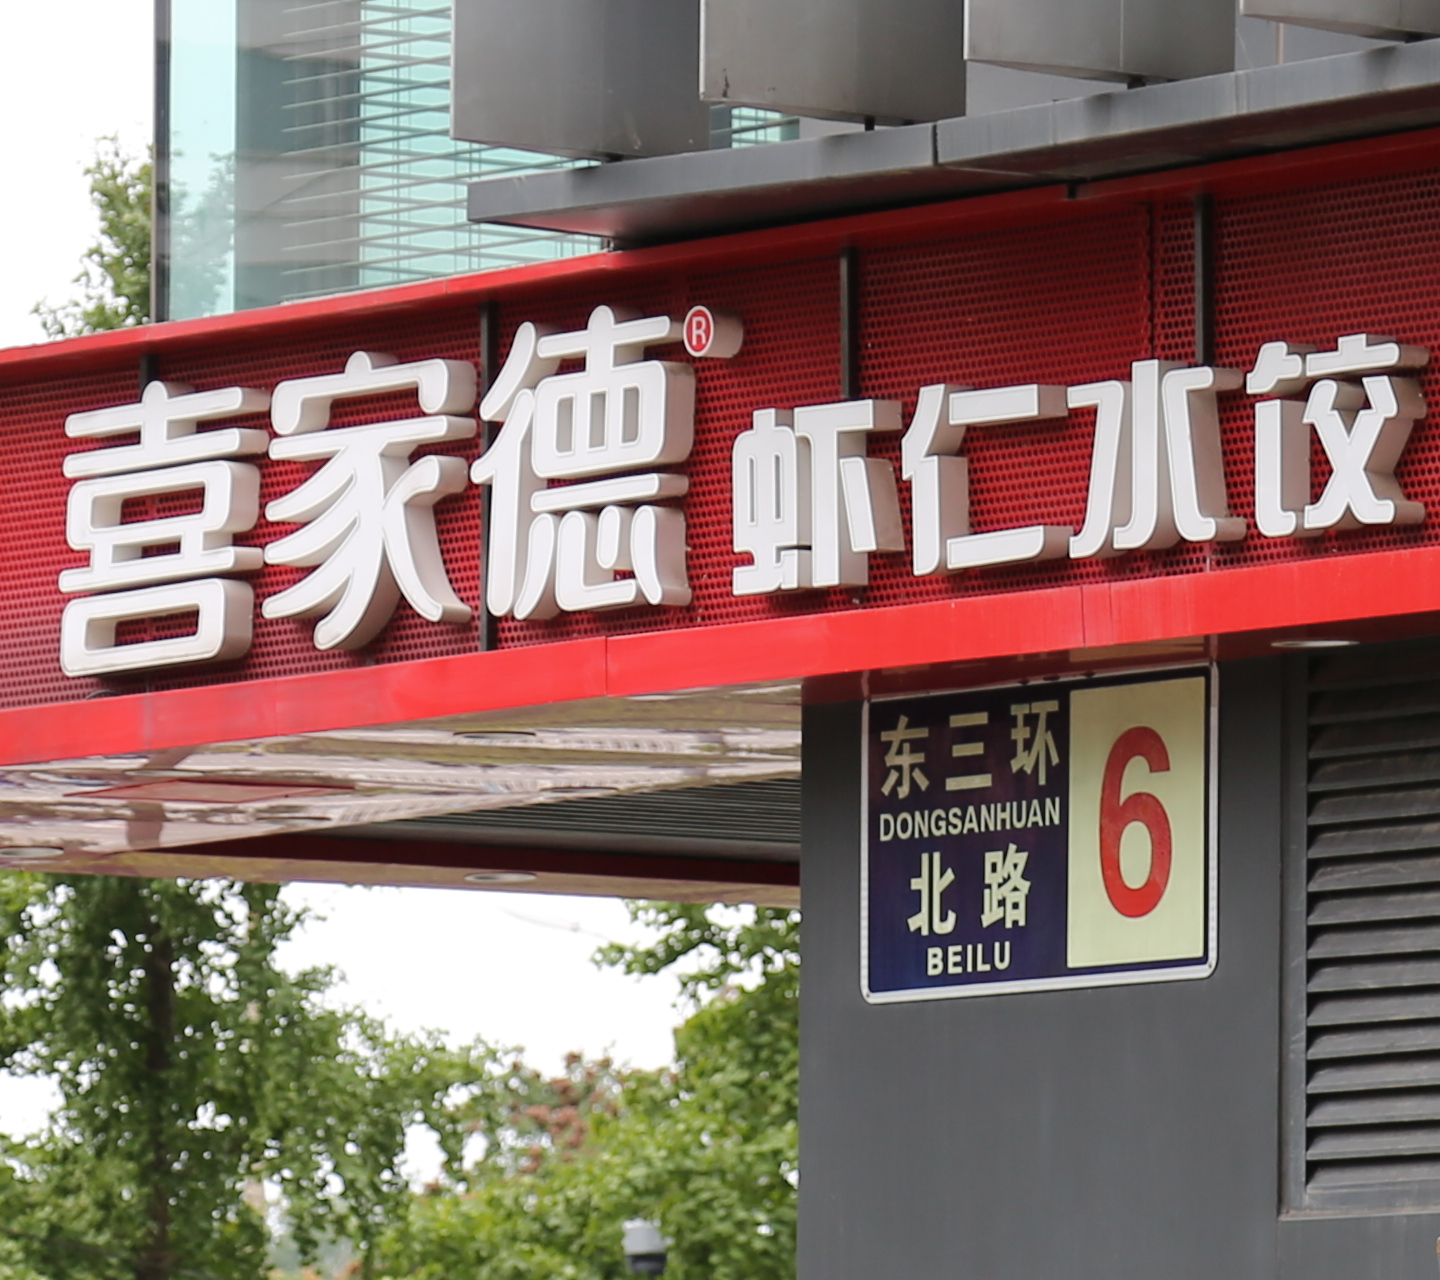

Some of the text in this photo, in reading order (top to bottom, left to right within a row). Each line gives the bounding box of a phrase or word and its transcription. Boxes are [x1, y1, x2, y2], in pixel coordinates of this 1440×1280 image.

[58, 304, 698, 678] 喜家德
[732, 332, 1430, 596] 虾仁水饺
[879, 698, 1061, 800] 东三环
[878, 796, 1061, 843] DONGSANHUAN
[1098, 724, 1173, 919] 6
[906, 841, 1032, 937] 北路
[925, 940, 1012, 977] BEILU
